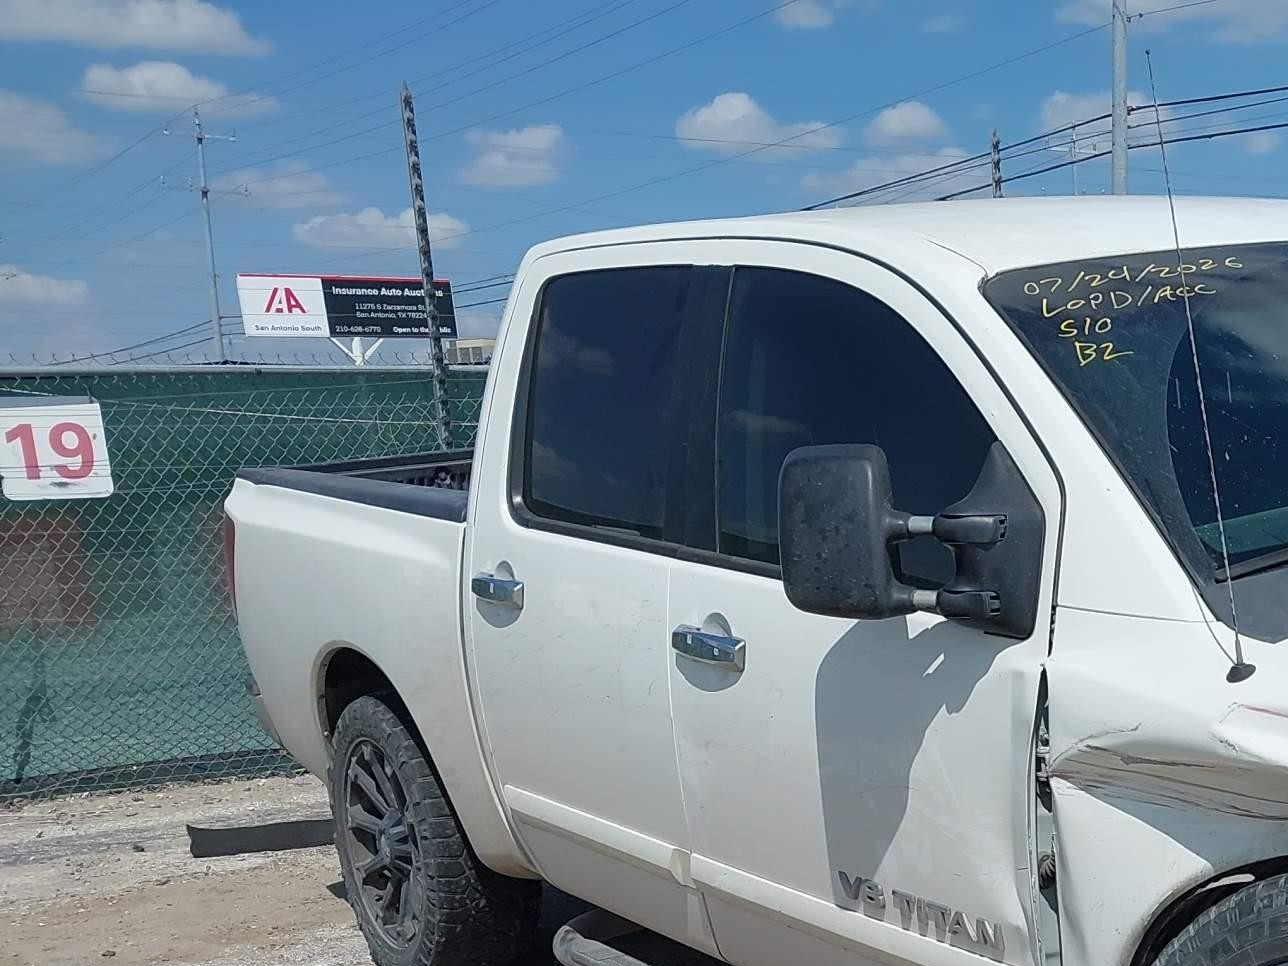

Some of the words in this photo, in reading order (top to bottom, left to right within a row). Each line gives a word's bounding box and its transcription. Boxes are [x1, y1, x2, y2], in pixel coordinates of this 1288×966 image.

[332, 286, 379, 296] Insurance
[380, 287, 402, 296] Auto
[1023, 256, 1244, 296] 07/24/2026
[393, 326, 411, 334] Open
[1074, 341, 1135, 367] B2
[5, 422, 94, 480] 19
[837, 870, 885, 909] V8
[891, 889, 1006, 950] TITAN
